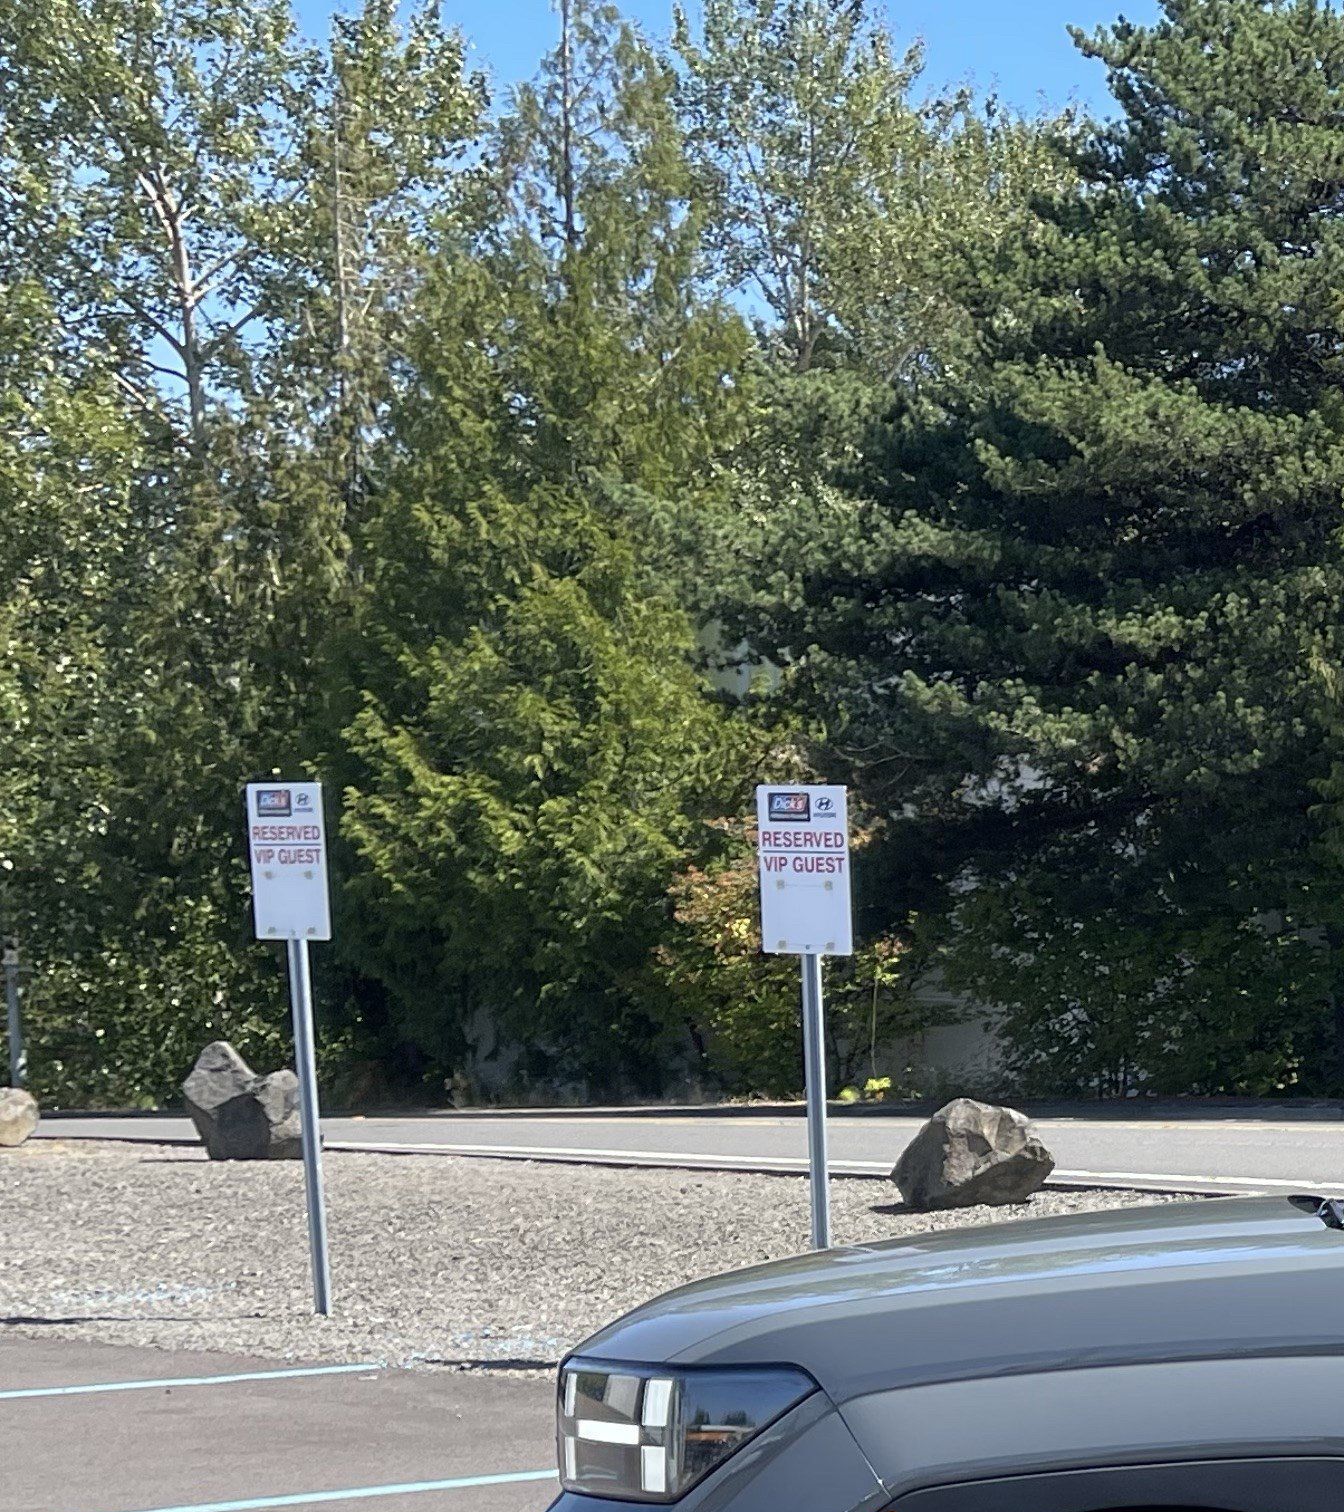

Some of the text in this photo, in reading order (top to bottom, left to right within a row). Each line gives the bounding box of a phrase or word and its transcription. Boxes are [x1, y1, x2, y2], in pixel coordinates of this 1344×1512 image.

[252, 826, 321, 841] RESERVED
[761, 831, 845, 849] RESERVED
[254, 849, 321, 865] VIP GUEST
[763, 856, 845, 874] VIP GUEST
